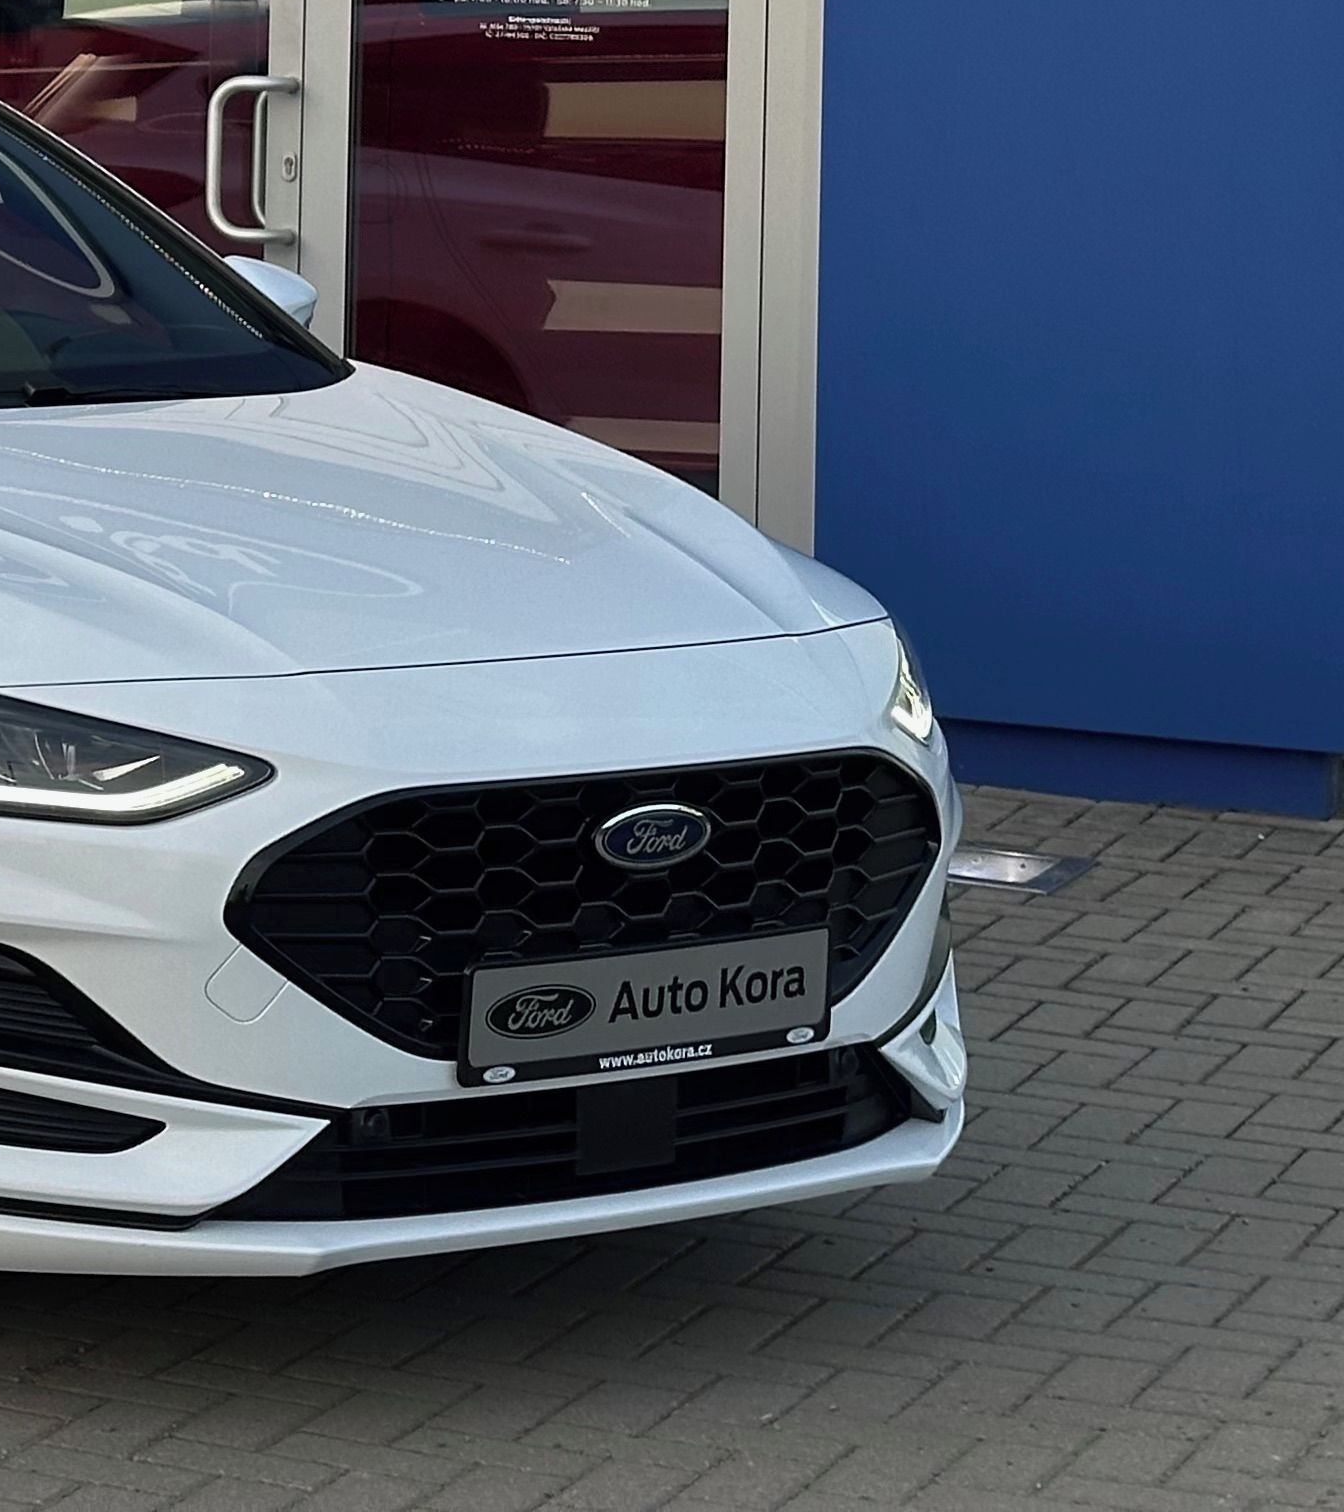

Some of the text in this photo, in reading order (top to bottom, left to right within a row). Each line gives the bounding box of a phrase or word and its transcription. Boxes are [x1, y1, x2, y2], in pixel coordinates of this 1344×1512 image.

[626, 817, 689, 856] Ford
[507, 964, 806, 1031] Ford Auto Kora
[598, 1042, 713, 1069] www.autokora.cz
